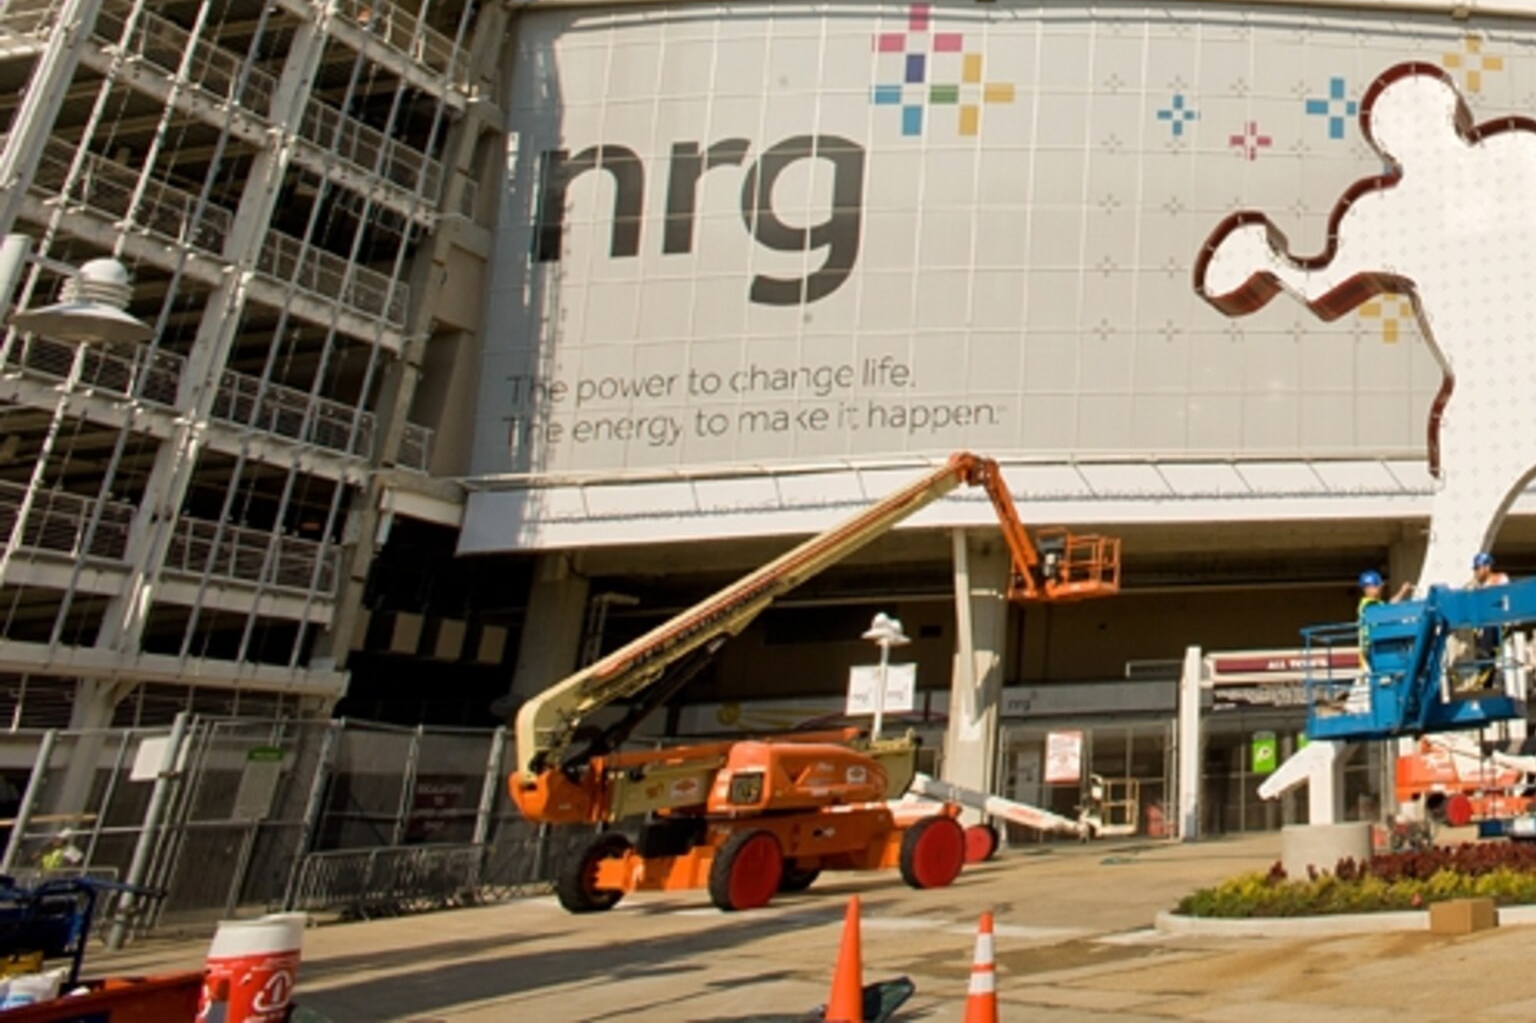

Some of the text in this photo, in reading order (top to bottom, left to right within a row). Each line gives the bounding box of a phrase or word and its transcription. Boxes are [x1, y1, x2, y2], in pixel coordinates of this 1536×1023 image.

[532, 133, 867, 307] nrg
[506, 354, 916, 408] The power to change life.
[502, 397, 1000, 448] The energy to make it happen.
